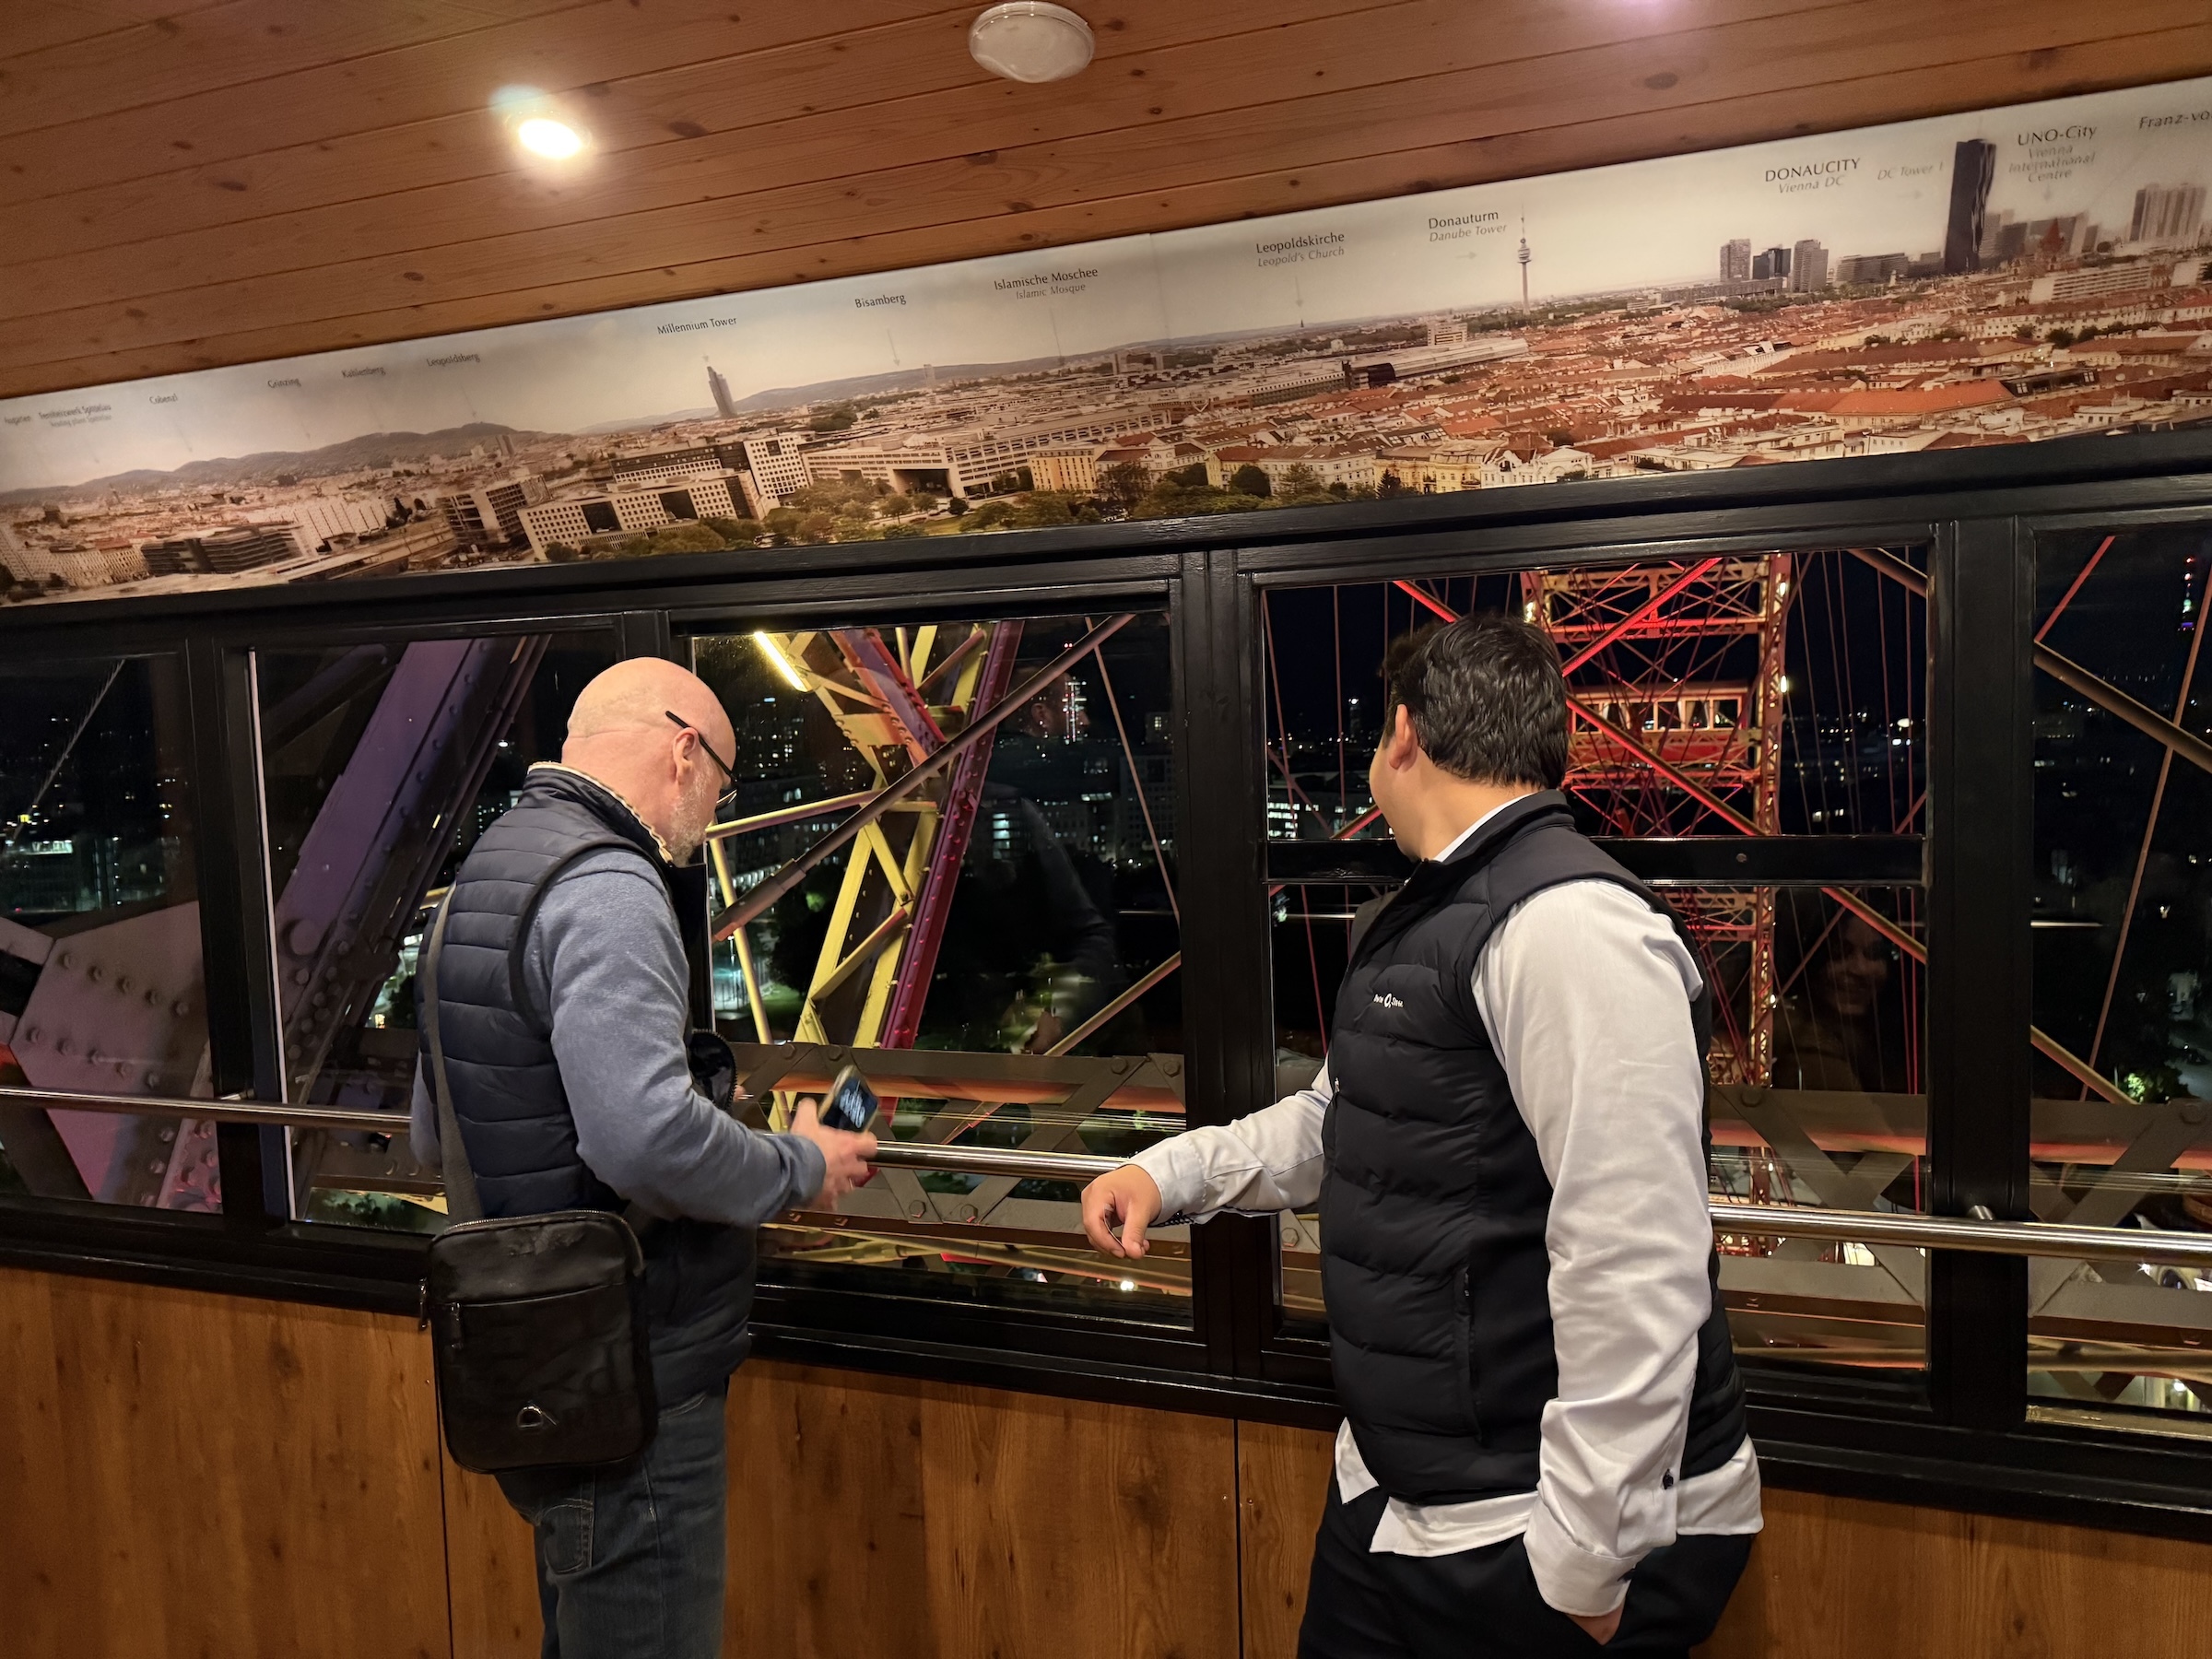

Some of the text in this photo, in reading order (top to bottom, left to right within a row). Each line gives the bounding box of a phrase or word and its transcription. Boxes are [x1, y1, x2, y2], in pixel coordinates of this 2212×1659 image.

[2139, 110, 2212, 130] Franz-vo
[2018, 124, 2097, 147] UNO-City
[2029, 145, 2073, 159] Vienna
[1765, 158, 1861, 182] DONAUCITY
[1877, 169, 1893, 181] DC
[1900, 164, 1934, 177] Tower
[1779, 175, 1845, 194] Vienna DC
[1429, 212, 1499, 229] Donauturm
[1430, 224, 1508, 242] Danube Tower
[1256, 231, 1345, 254] Leopoldskirche
[1258, 245, 1345, 267] Leopold's Church
[994, 268, 1099, 290] Islamische Moschee
[1016, 283, 1086, 300] Islamic Mosque
[854, 293, 906, 309] Bisamberg
[657, 317, 737, 335] Millennium Tower
[426, 352, 481, 367] Leopoldsberg
[342, 366, 386, 379] Kahlenberg
[267, 378, 301, 389] Grinzing
